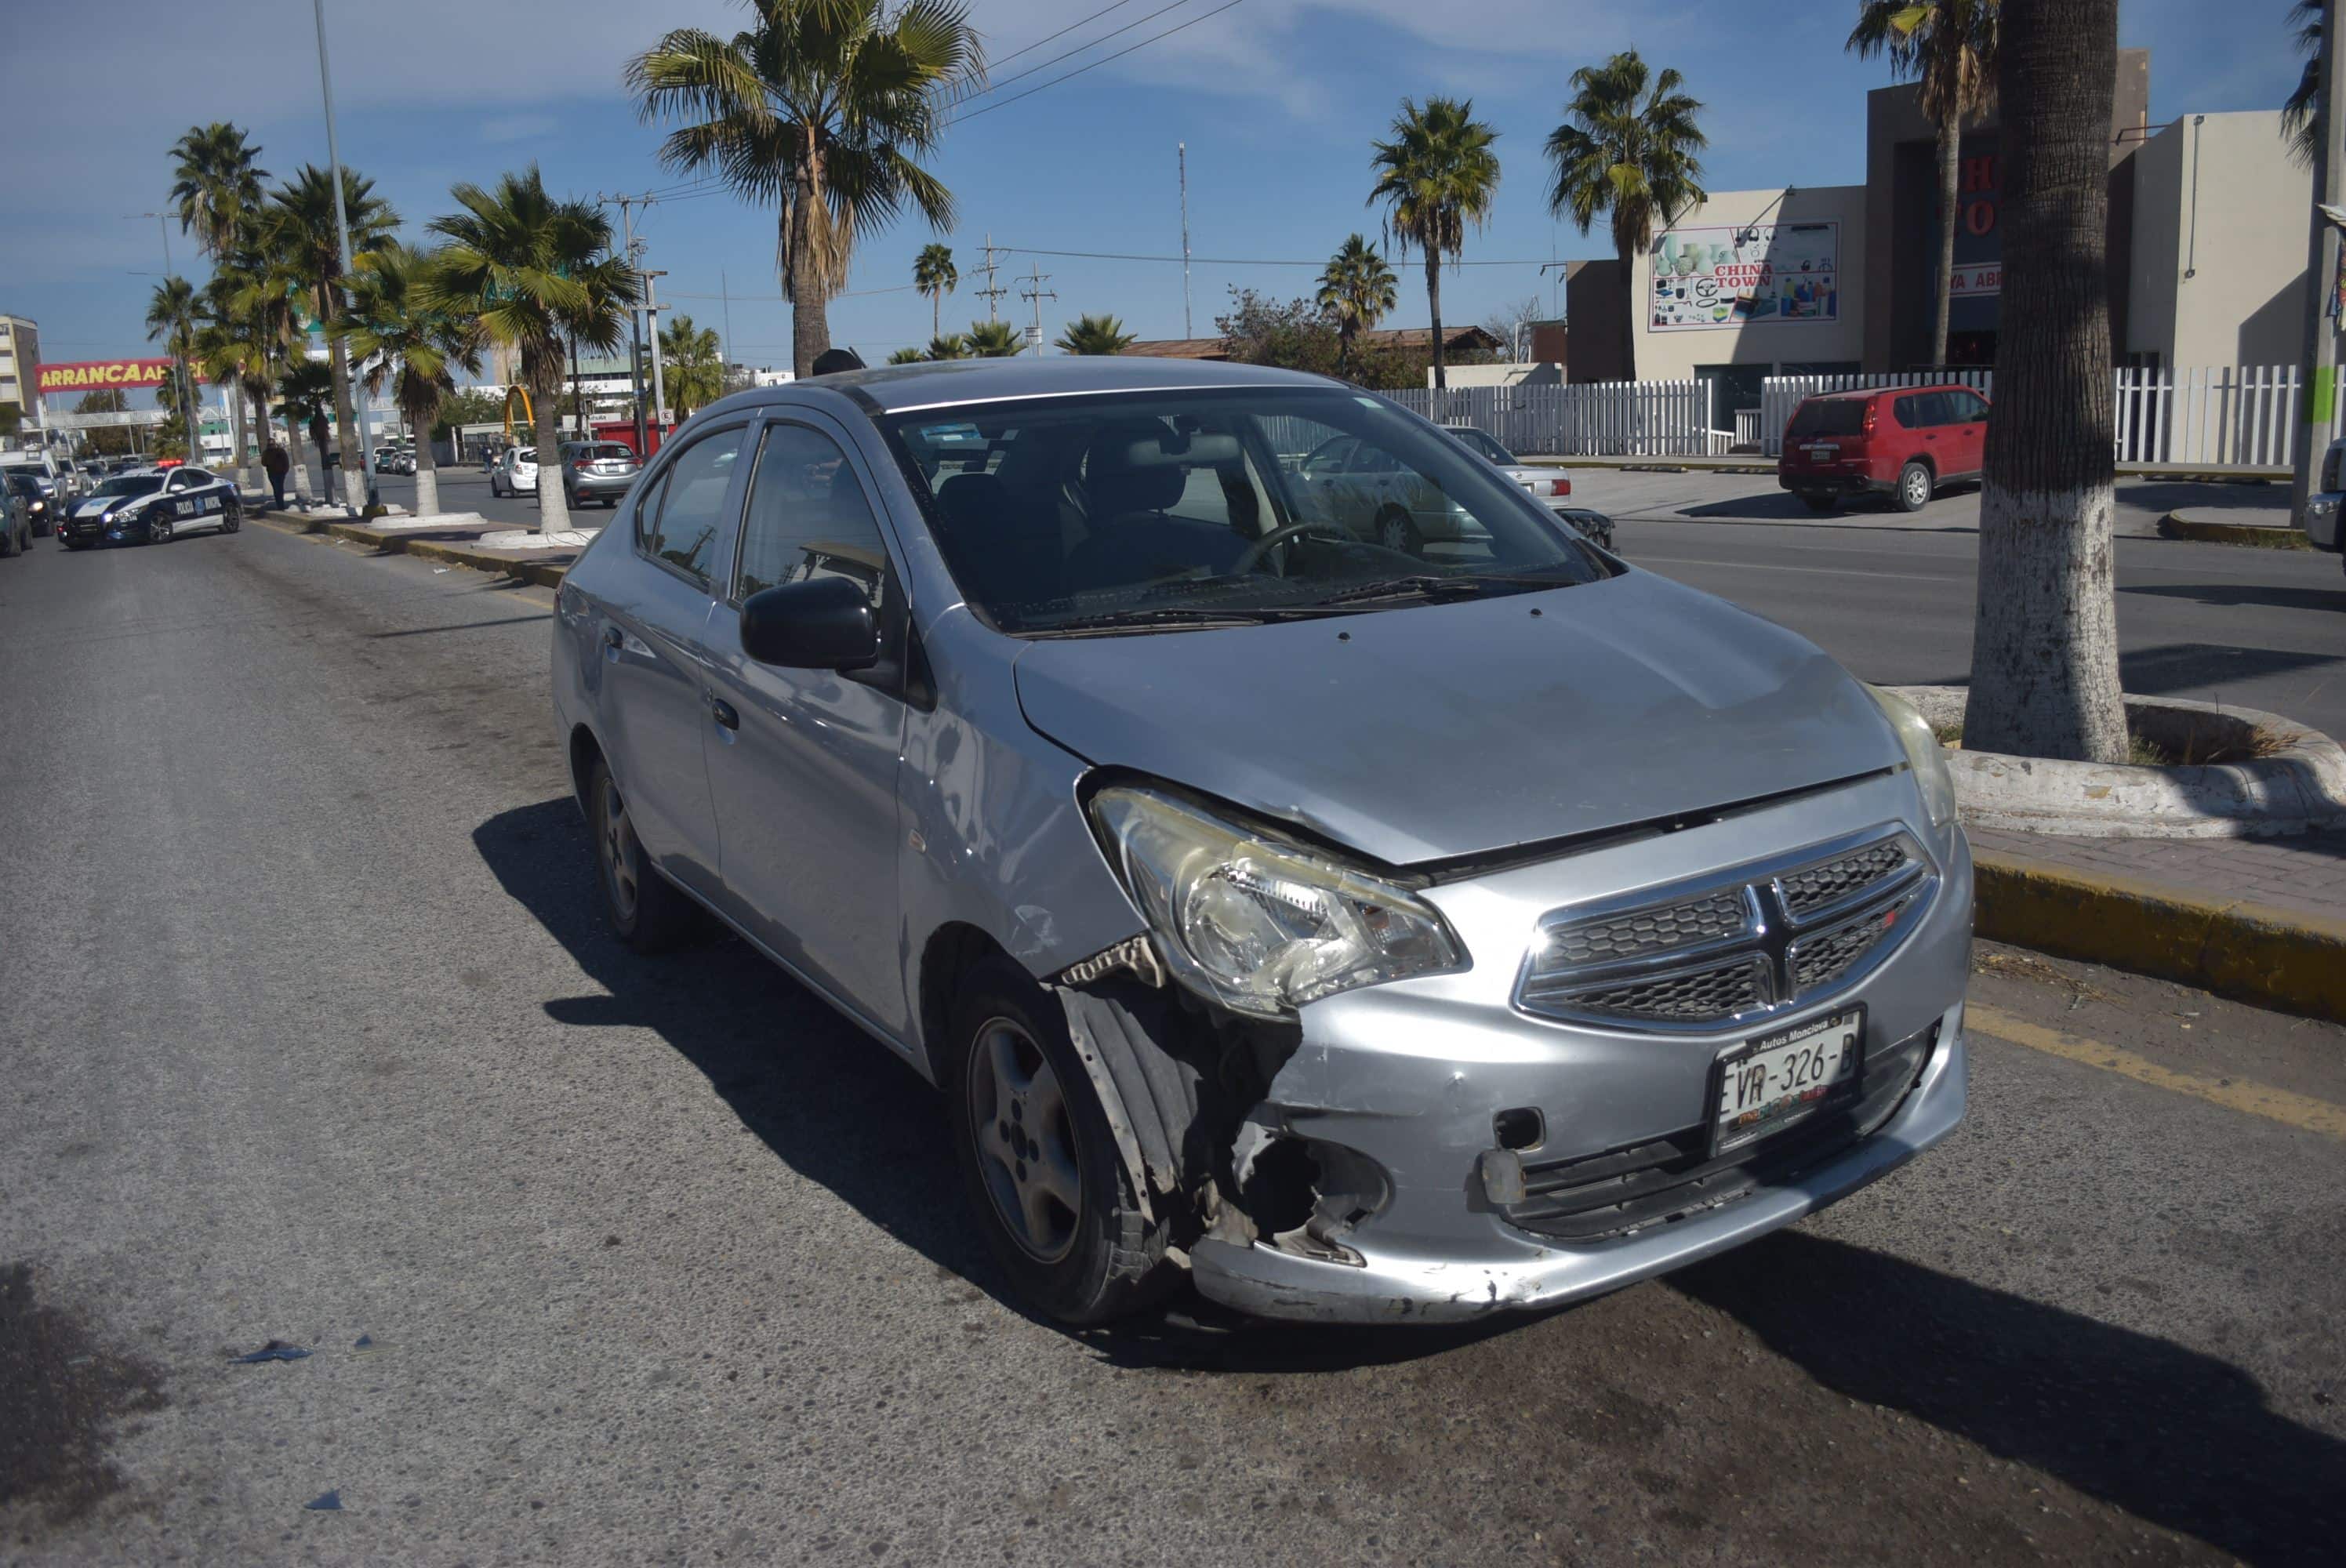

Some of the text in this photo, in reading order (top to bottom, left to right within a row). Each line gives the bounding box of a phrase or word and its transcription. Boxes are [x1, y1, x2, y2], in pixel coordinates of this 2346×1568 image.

[1715, 264, 1772, 276] CHINA
[1716, 276, 1771, 288] TOWN
[42, 364, 141, 387] ARRANCA
[1760, 1020, 1828, 1051] Autos Monclova
